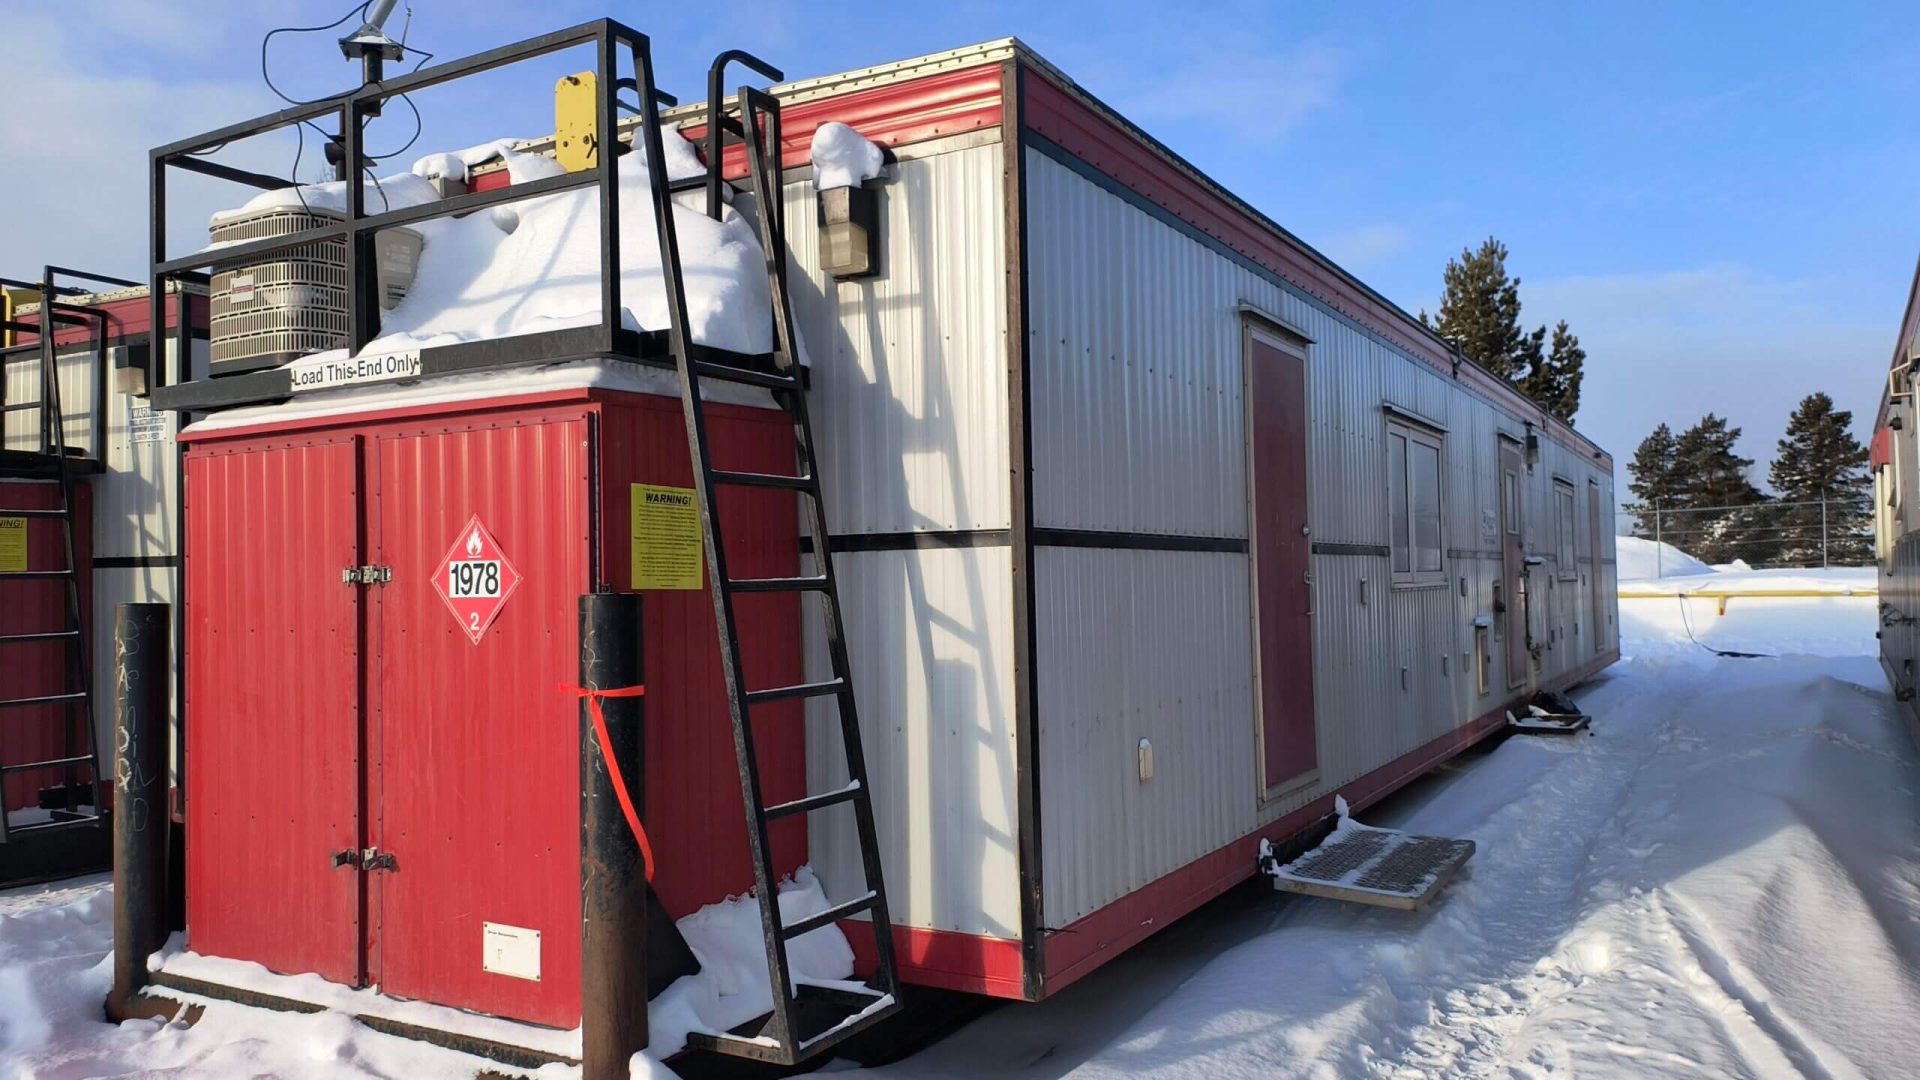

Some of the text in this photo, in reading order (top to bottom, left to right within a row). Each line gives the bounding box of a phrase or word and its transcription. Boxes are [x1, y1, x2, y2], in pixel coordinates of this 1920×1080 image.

[293, 354, 417, 386] Load This End Only
[645, 492, 692, 506] WARNING!
[451, 562, 499, 595] 1978
[470, 612, 480, 631] 2
